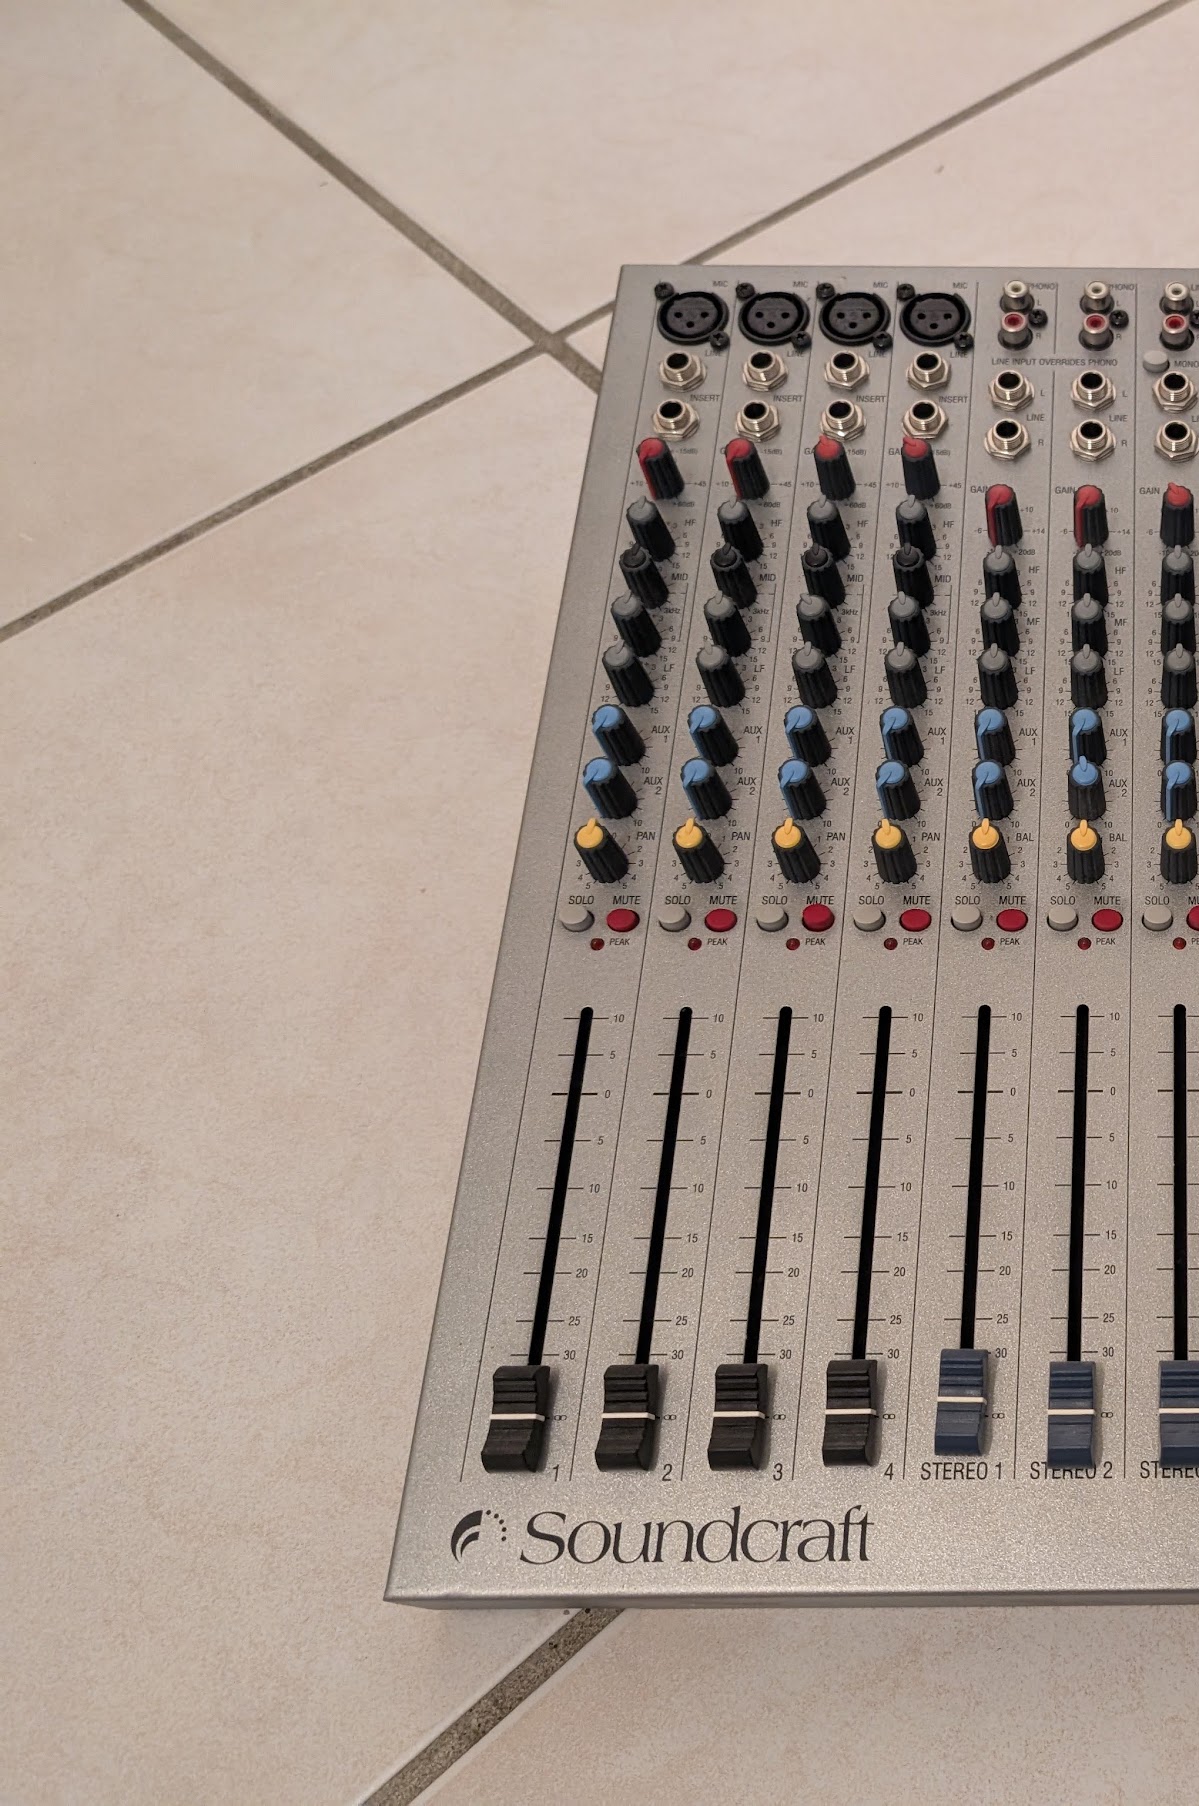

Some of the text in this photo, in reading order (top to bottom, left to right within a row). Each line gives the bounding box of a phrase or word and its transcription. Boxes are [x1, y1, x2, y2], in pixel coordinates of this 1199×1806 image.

[991, 358, 1118, 366] LINE INPUT OVERRIDES PHONO
[1175, 360, 1199, 368] MONO
[1055, 486, 1076, 494] GAIN
[636, 832, 655, 841] PAN
[731, 832, 750, 841] PAN
[826, 832, 846, 841] PAN
[921, 833, 940, 841] PAN
[1016, 833, 1034, 841] BAL
[1109, 833, 1127, 841] BAL
[568, 895, 594, 905] SOLO
[612, 895, 641, 905] MUTE
[664, 895, 691, 905] SOLO
[709, 895, 738, 905] MUTE
[762, 895, 788, 905] SOLO
[806, 895, 834, 905] MUTE
[858, 895, 885, 905] SOLO
[903, 895, 931, 905] MUTE
[955, 895, 981, 905] SOLO
[999, 895, 1027, 905] MUTE
[1050, 895, 1076, 905] SOLO
[1093, 895, 1121, 905] MUTE
[1144, 895, 1170, 905] SOLO
[609, 937, 630, 946] PEAK
[707, 937, 728, 946] PEAK
[805, 937, 826, 946] PEAK
[903, 937, 923, 946] PEAK
[1000, 937, 1020, 946] PEAK
[1096, 937, 1116, 946] PEAK
[552, 1464, 560, 1482] 1
[662, 1463, 673, 1482] 2
[772, 1463, 783, 1481] 3
[883, 1462, 894, 1481] 4
[921, 1461, 1002, 1480] STEREO 1
[1103, 1461, 1113, 1479] 2
[519, 1504, 875, 1565] Soundcraft
